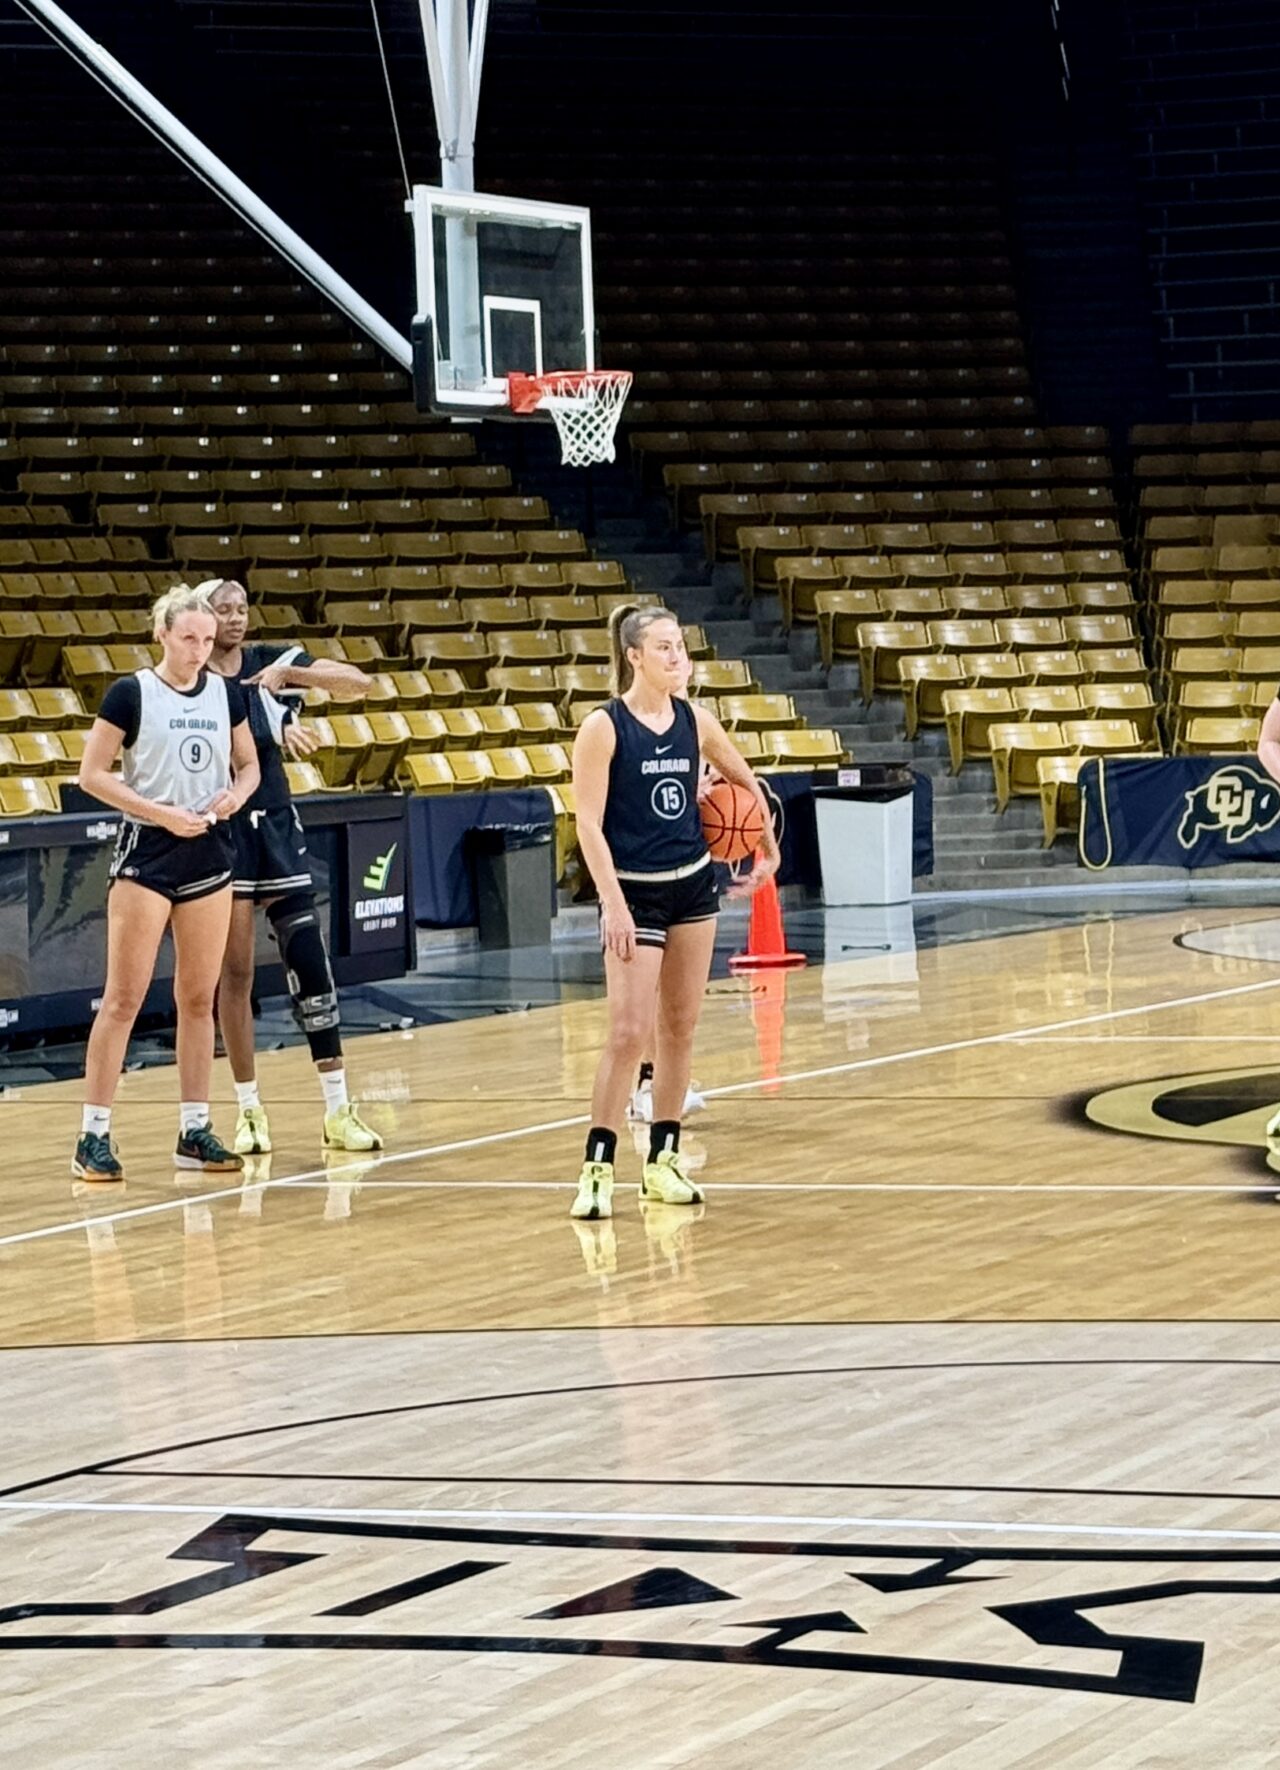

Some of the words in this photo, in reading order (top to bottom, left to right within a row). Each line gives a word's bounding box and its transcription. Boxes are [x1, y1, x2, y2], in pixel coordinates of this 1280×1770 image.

[169, 718, 218, 731] COLORADO
[191, 743, 201, 764] 9
[641, 758, 690, 775] COLORADO
[660, 785, 680, 811] 15
[1206, 776, 1256, 826] CU
